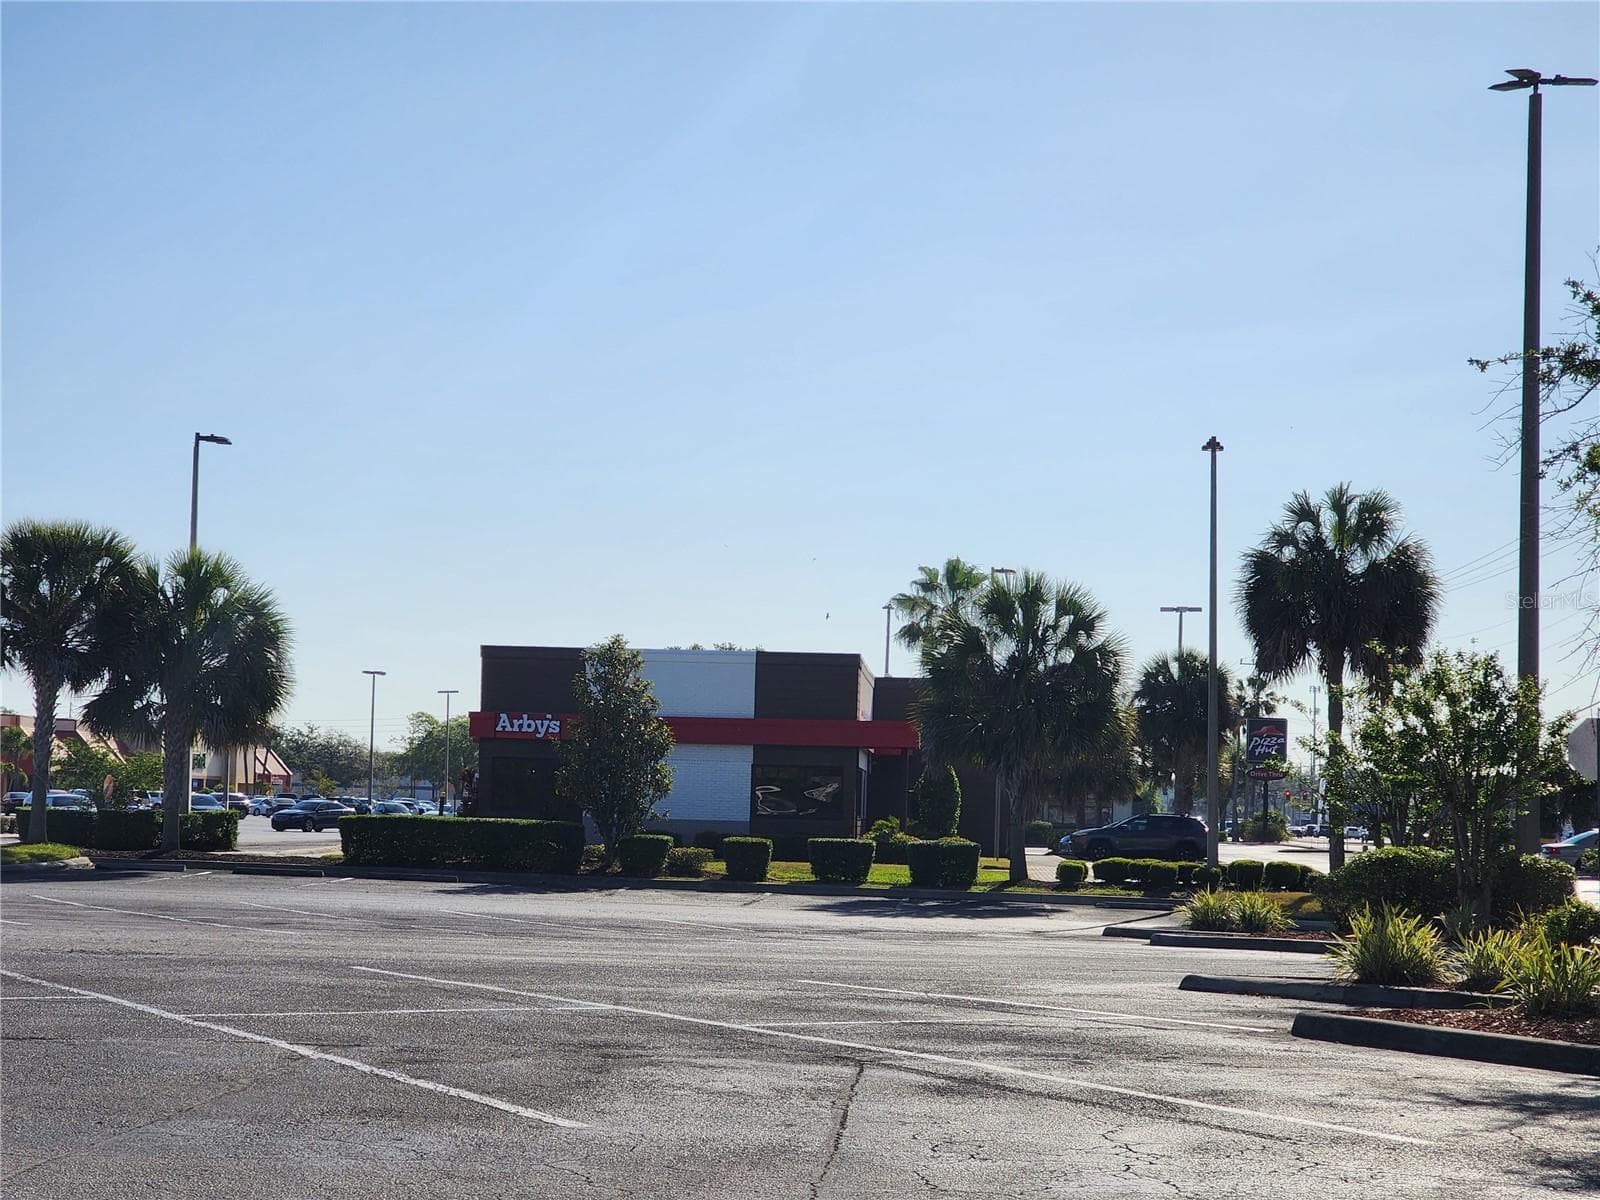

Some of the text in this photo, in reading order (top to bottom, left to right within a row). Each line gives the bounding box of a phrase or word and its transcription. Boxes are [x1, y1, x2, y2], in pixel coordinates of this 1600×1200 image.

[495, 713, 561, 738] Arby's
[1248, 733, 1285, 751] Pizza
[1254, 744, 1280, 756] Hut
